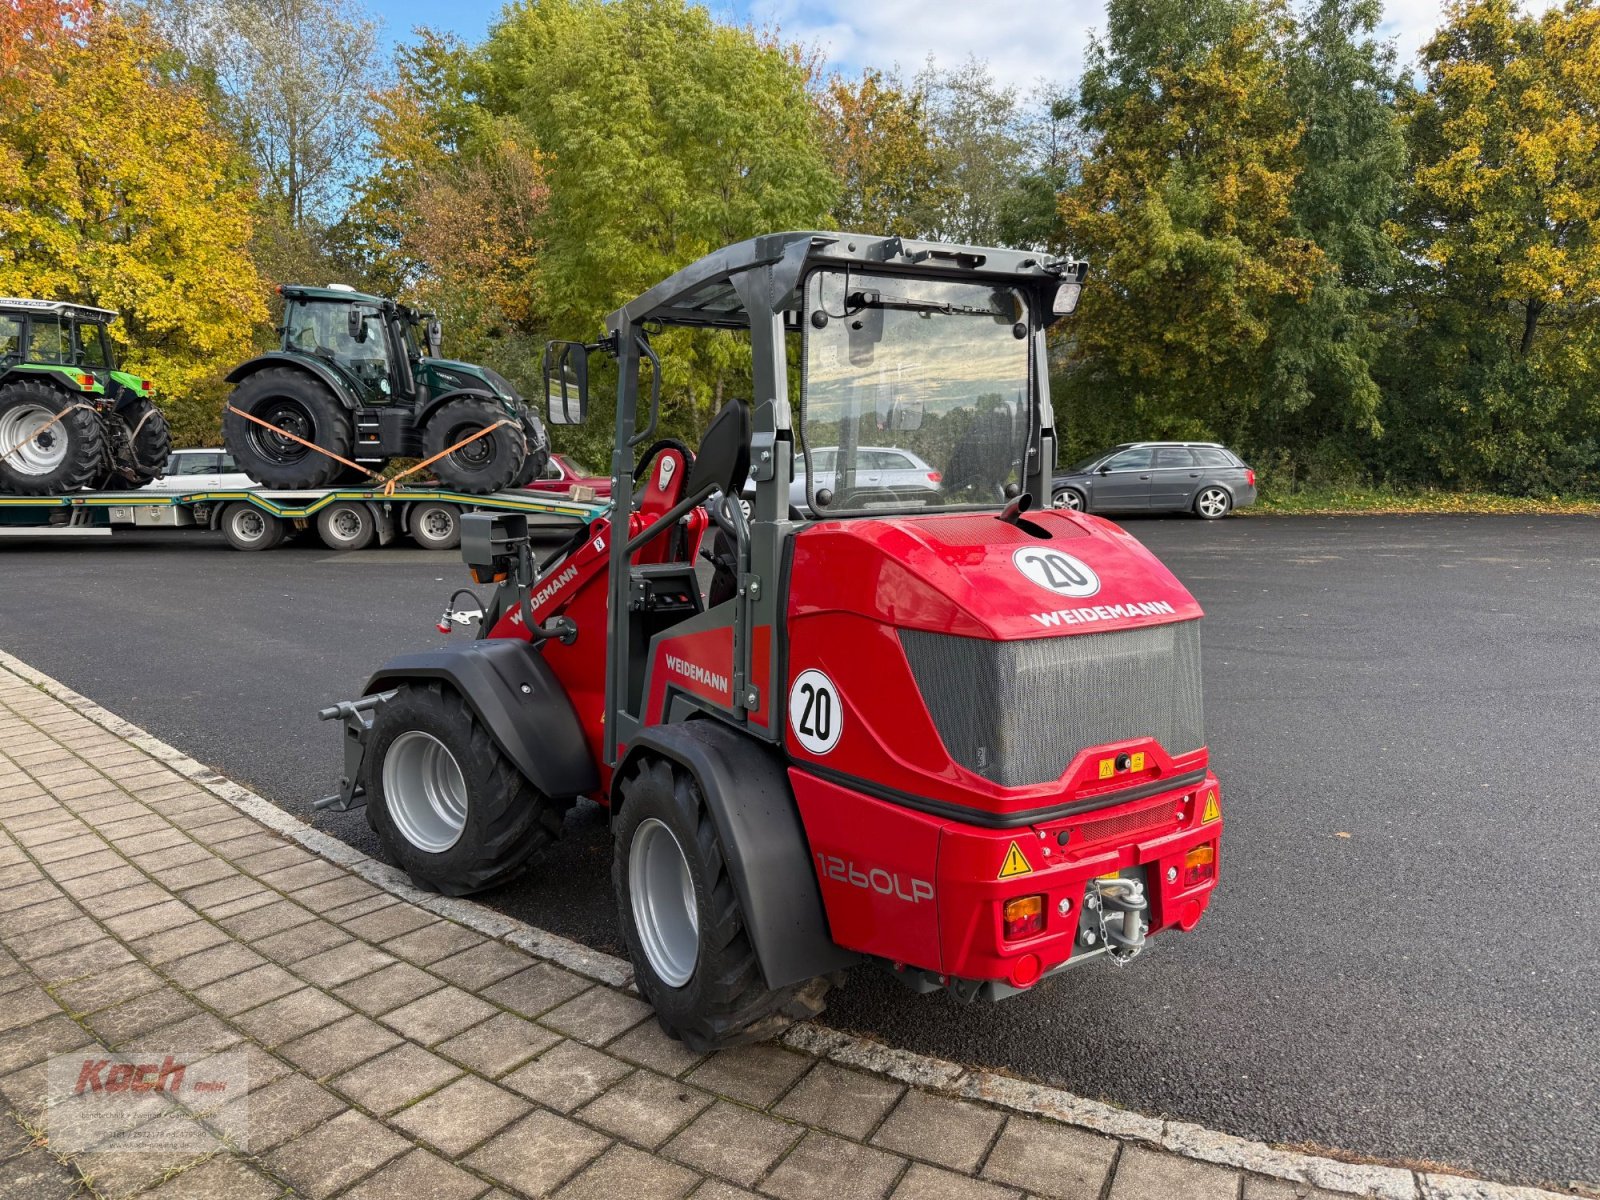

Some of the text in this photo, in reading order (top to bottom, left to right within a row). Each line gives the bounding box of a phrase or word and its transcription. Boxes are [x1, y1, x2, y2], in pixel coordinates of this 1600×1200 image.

[1025, 554, 1089, 588] 20
[509, 564, 578, 625] WDEMANN
[1030, 600, 1176, 628] WEIDEMANN
[665, 653, 728, 694] WEIDEMANN
[799, 682, 832, 741] 20
[817, 852, 935, 903] 1260LP
